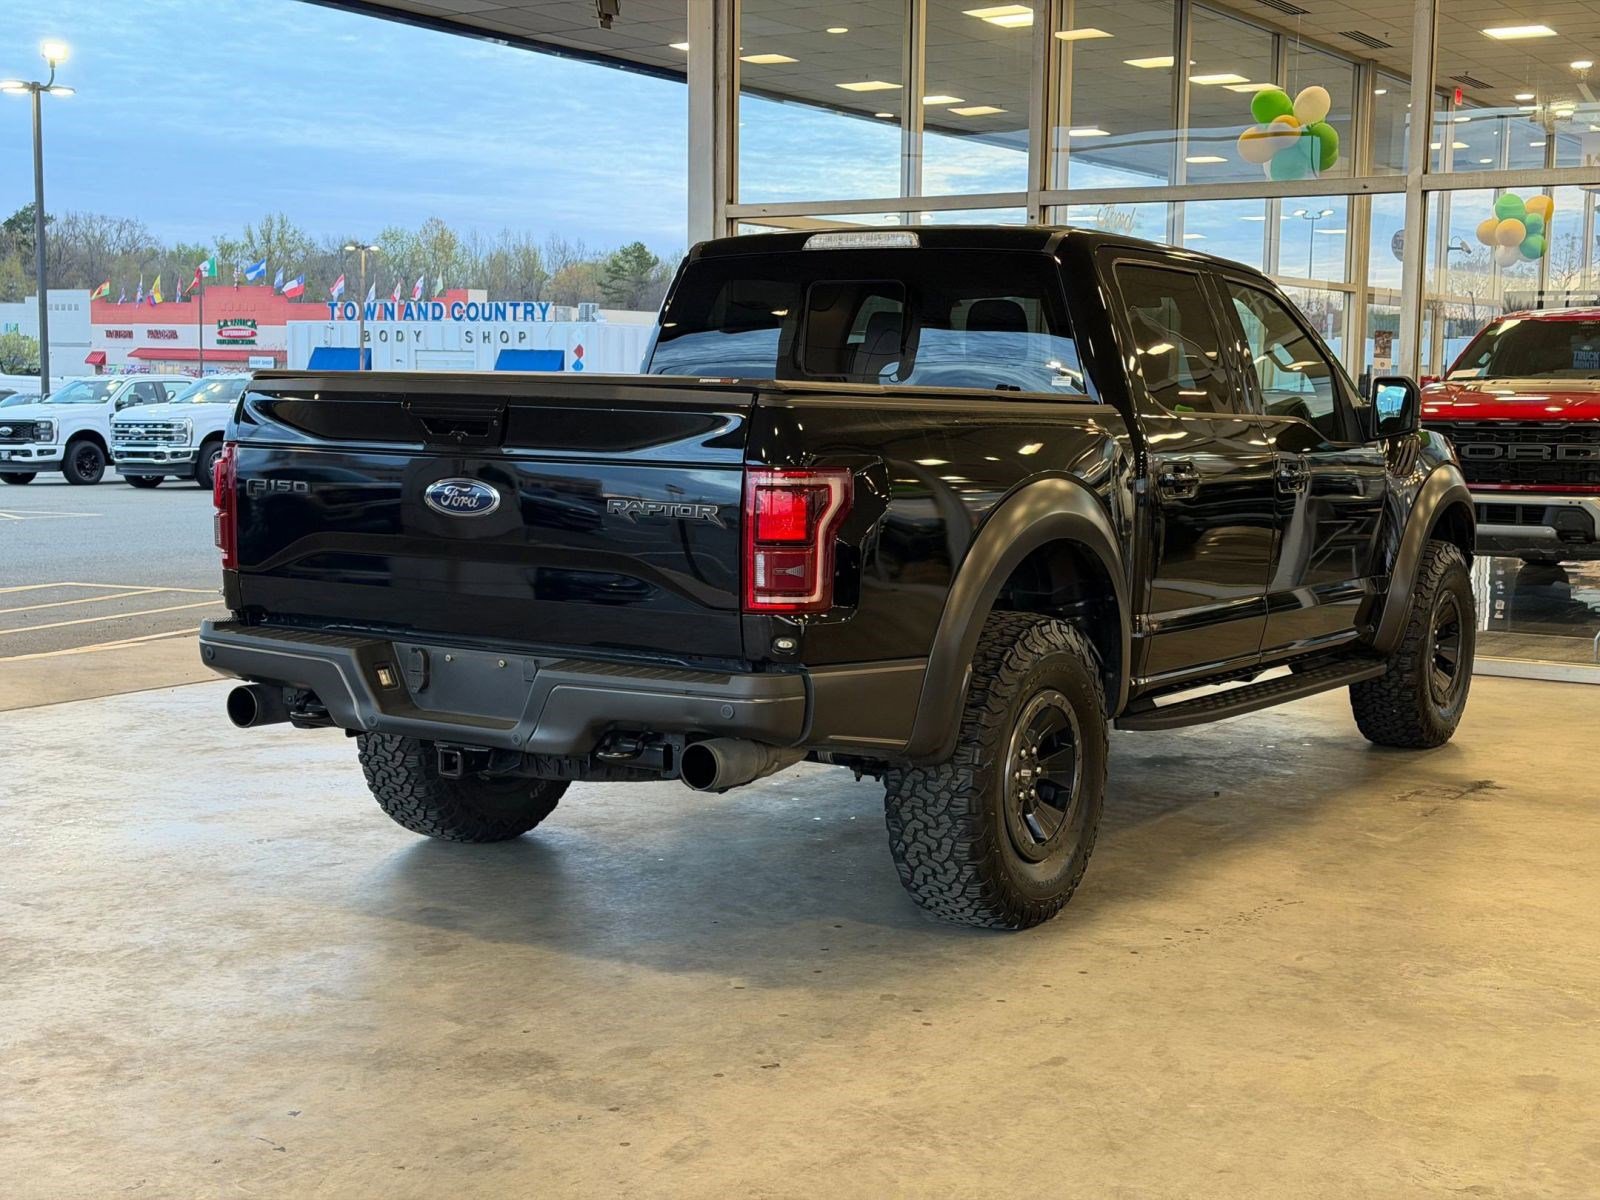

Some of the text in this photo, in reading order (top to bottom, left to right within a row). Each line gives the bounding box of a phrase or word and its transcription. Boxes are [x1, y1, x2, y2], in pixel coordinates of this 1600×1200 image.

[328, 302, 549, 321] TOWN AND COUNTRY
[363, 330, 527, 343] BODY SHOP
[1573, 351, 1600, 360] TRUCK
[1461, 443, 1600, 460] ORD
[440, 485, 480, 508] Ford
[606, 499, 727, 529] RAPTOR
